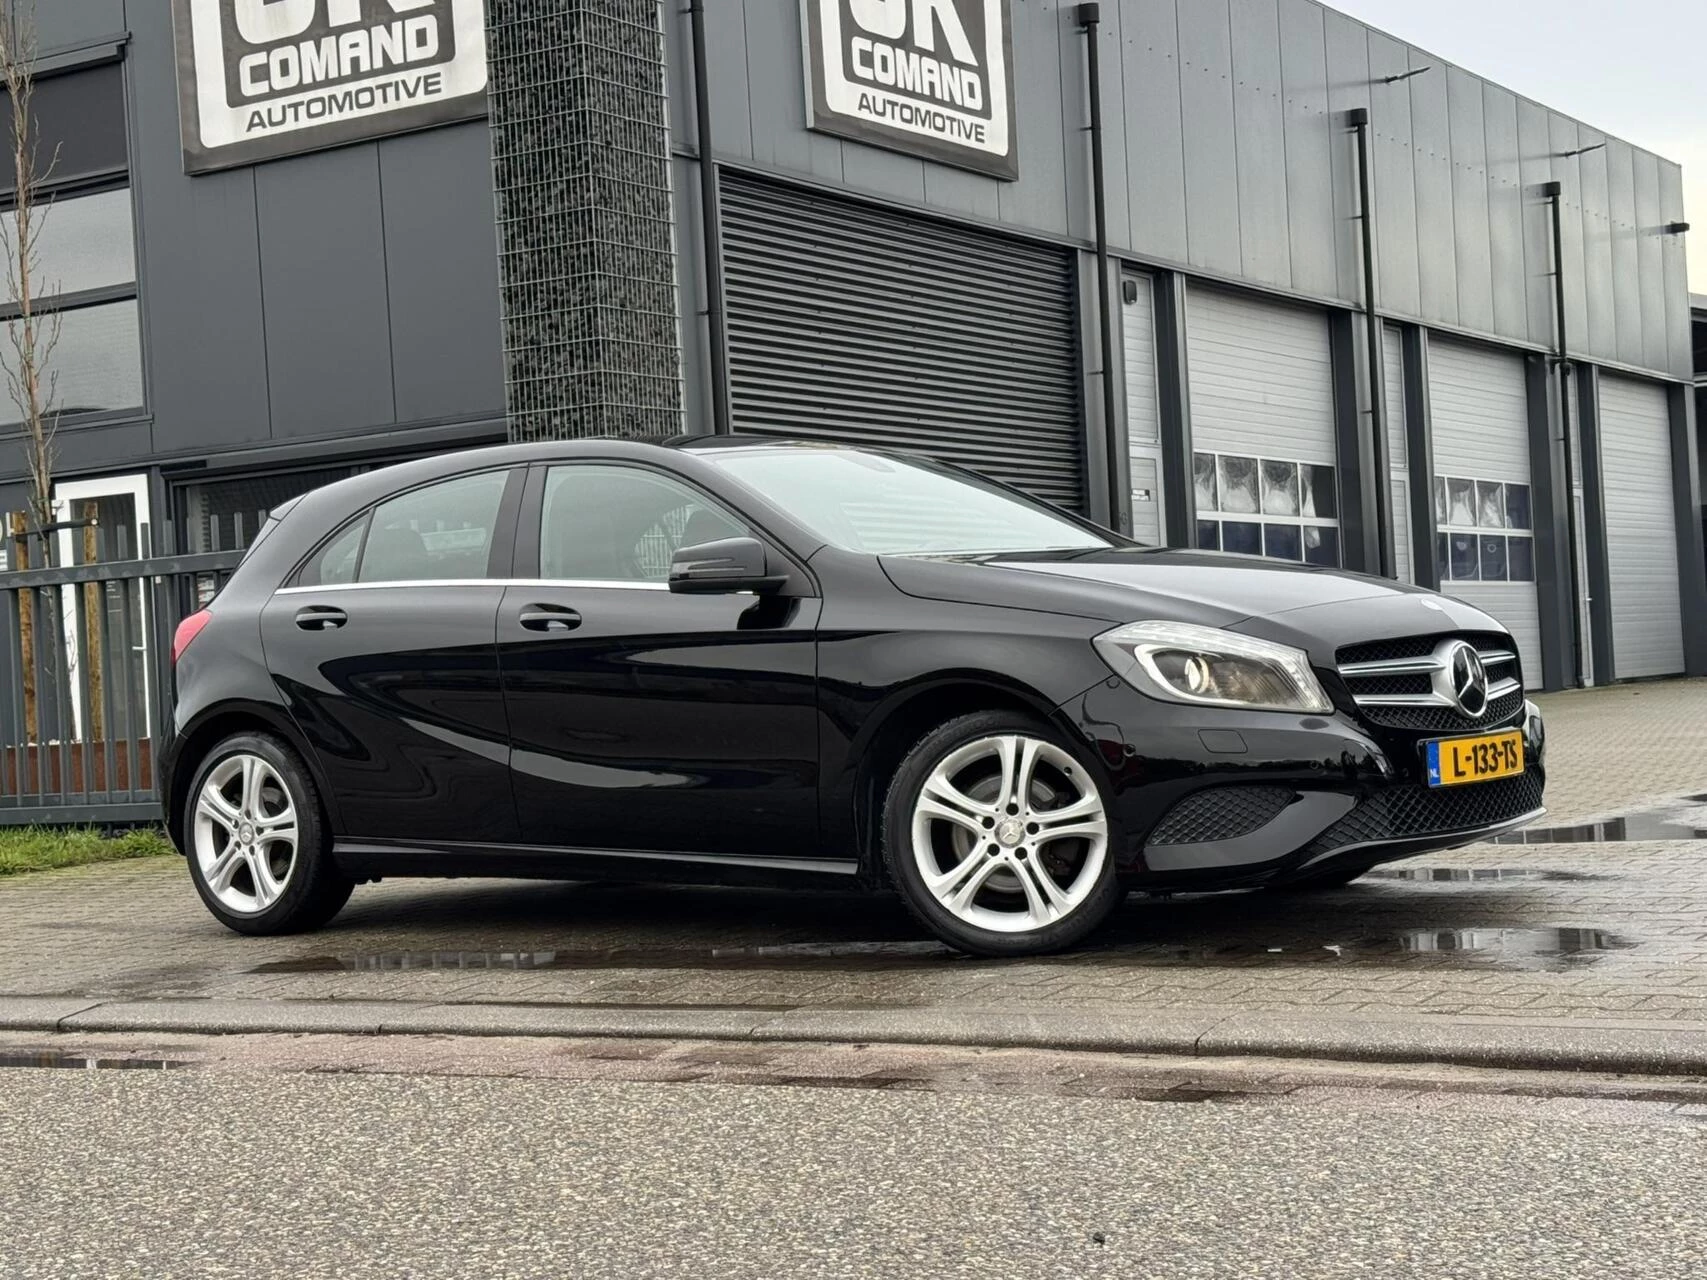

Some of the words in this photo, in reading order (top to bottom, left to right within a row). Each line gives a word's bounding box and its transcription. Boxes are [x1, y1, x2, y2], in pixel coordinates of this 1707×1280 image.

[239, 14, 440, 97] COMAND
[851, 36, 983, 111] COMAND
[246, 72, 442, 132] AUTOMOTIVE
[858, 93, 985, 144] AUTOMOTIVE
[1453, 739, 1517, 777] L-133-TS
